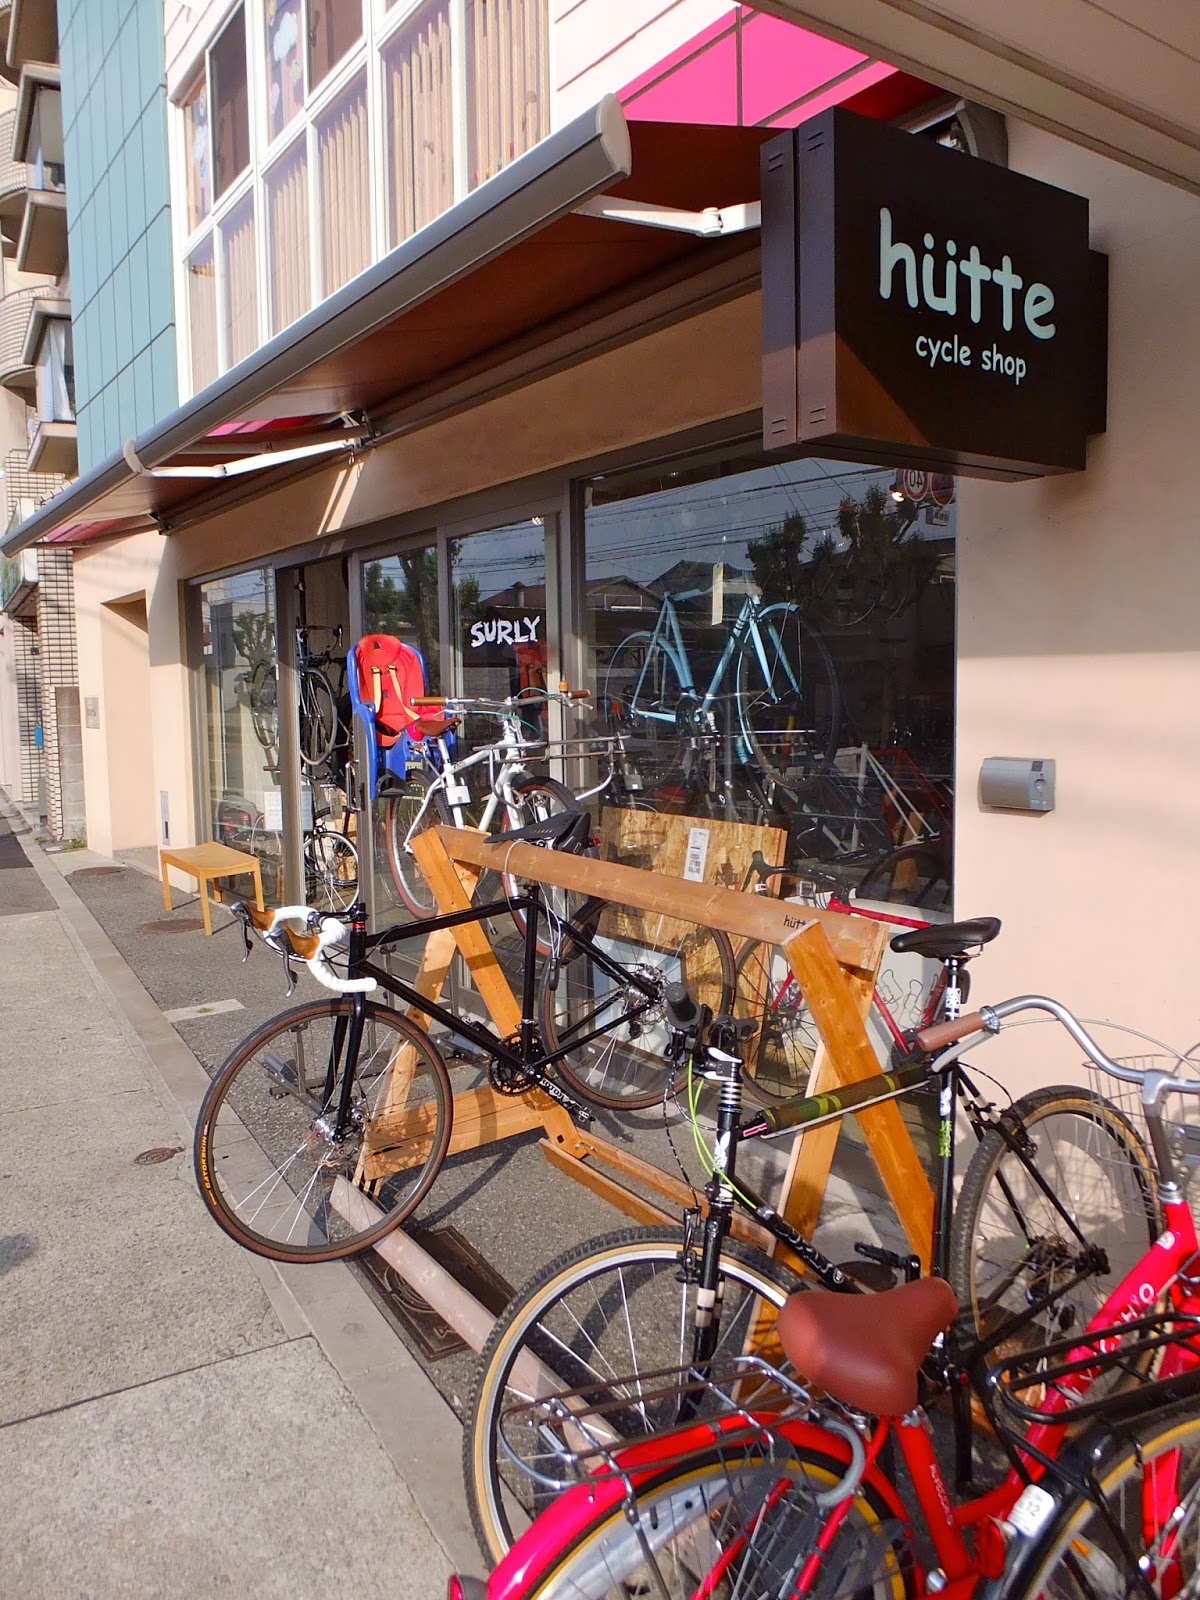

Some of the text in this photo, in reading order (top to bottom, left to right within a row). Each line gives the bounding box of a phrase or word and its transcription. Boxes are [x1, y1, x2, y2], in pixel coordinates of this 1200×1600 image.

[879, 207, 1056, 339] hütte
[915, 333, 1027, 386] cycle shop
[470, 615, 541, 648] SURLY
[783, 914, 807, 930] hütt
